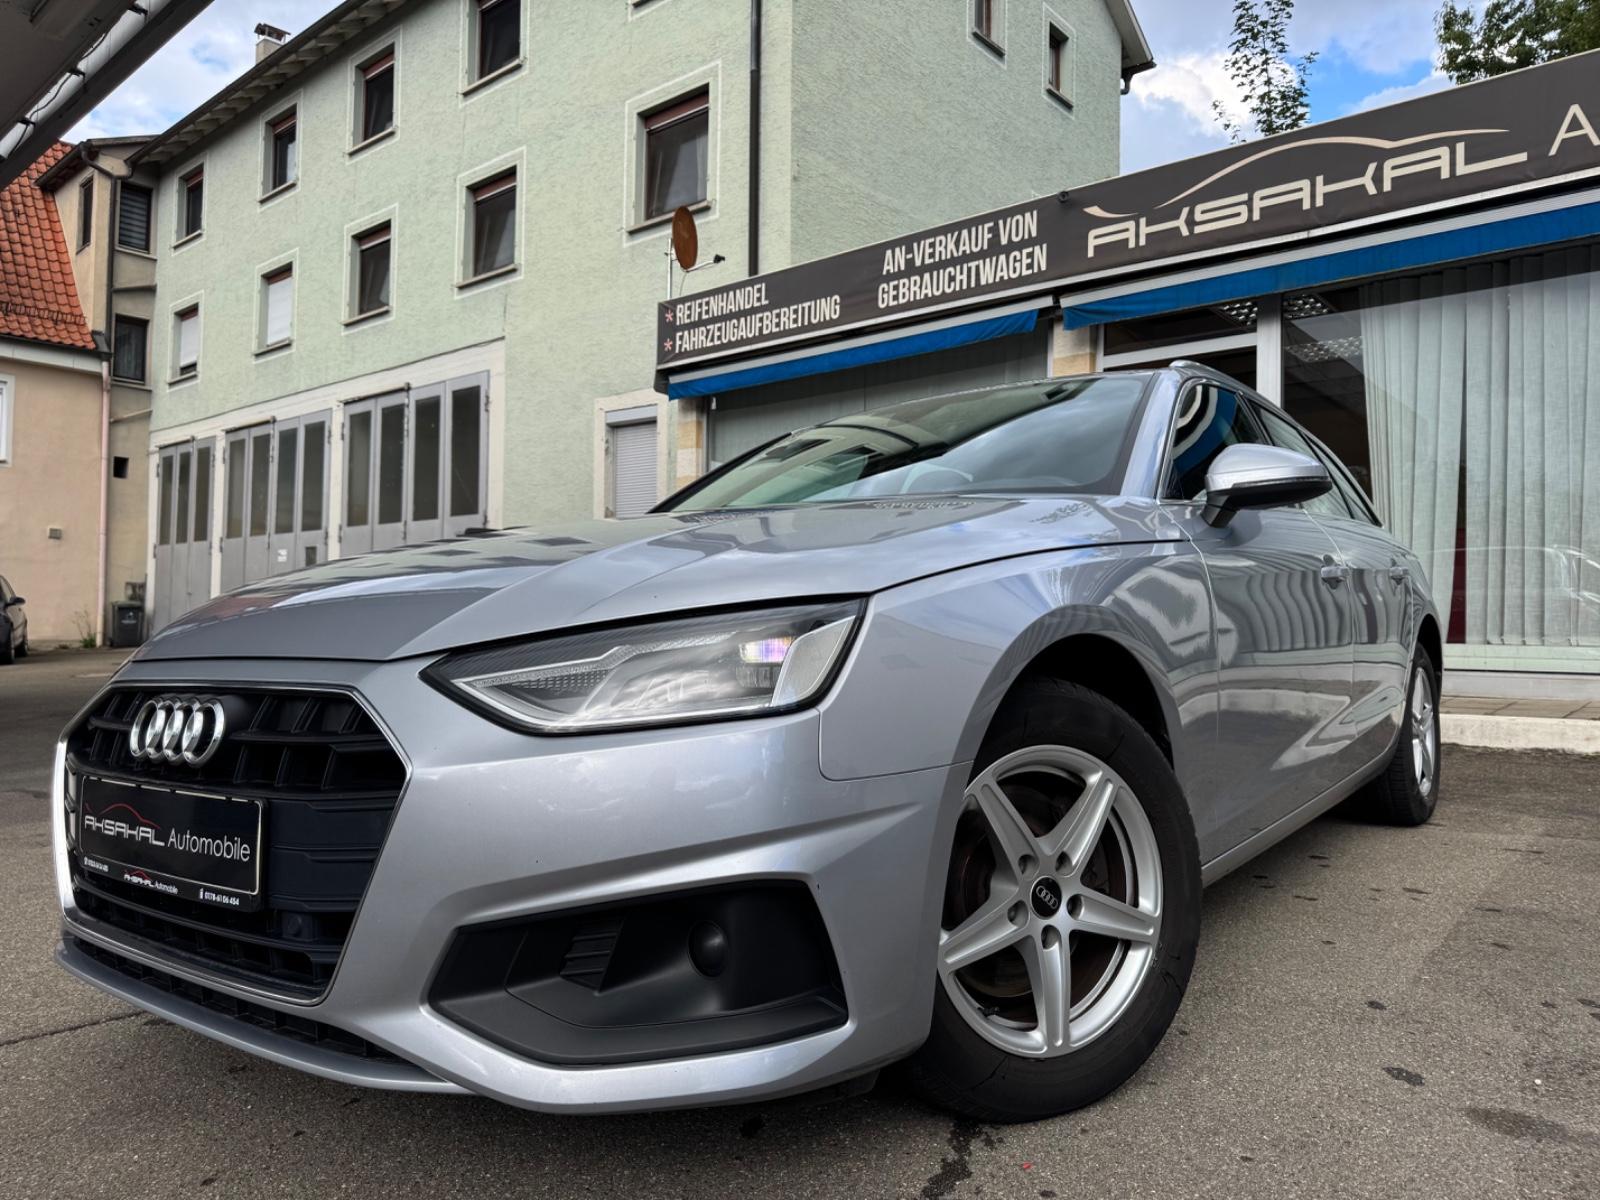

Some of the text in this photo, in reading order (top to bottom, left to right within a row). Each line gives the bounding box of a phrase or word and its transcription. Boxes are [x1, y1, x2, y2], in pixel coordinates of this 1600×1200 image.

[1087, 141, 1528, 258] AKSAKAL
[882, 210, 1038, 276] AN-VERKAUF VON
[676, 283, 768, 326] REIFENHANDEL
[878, 244, 1048, 309] GEBRAUCHTWAGEN
[675, 295, 841, 354] FAHRZEUGAUFBEREITUNG
[84, 815, 251, 862] AKSAKAL Automobile
